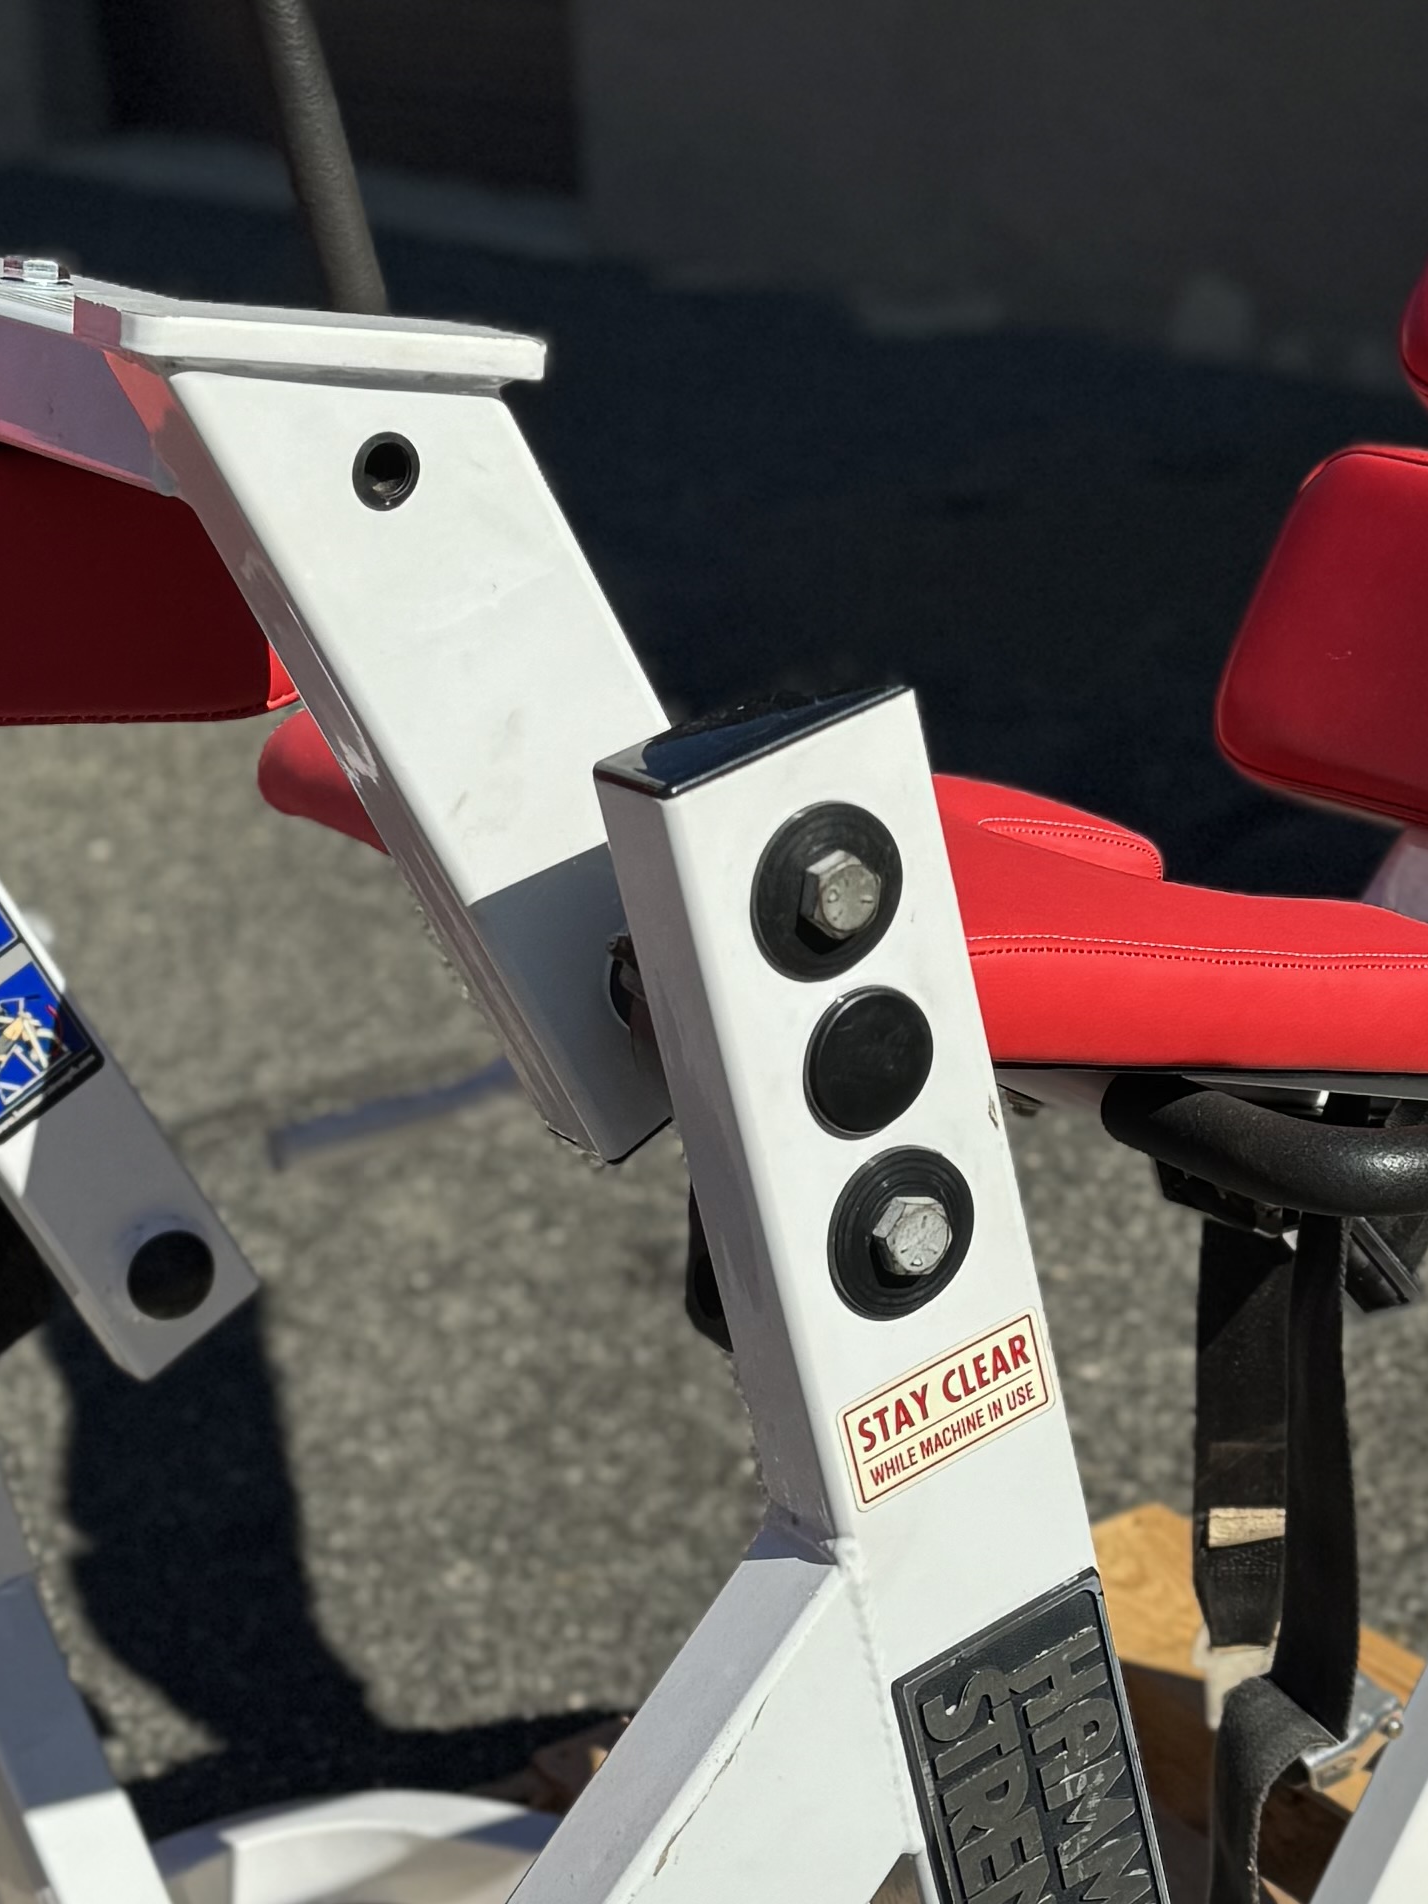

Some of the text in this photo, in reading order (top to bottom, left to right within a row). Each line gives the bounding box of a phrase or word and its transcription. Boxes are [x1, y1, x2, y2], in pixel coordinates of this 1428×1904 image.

[858, 1334, 1031, 1453] STAY CLEAR
[870, 1381, 1036, 1486] WHILE MACHINE IN USE
